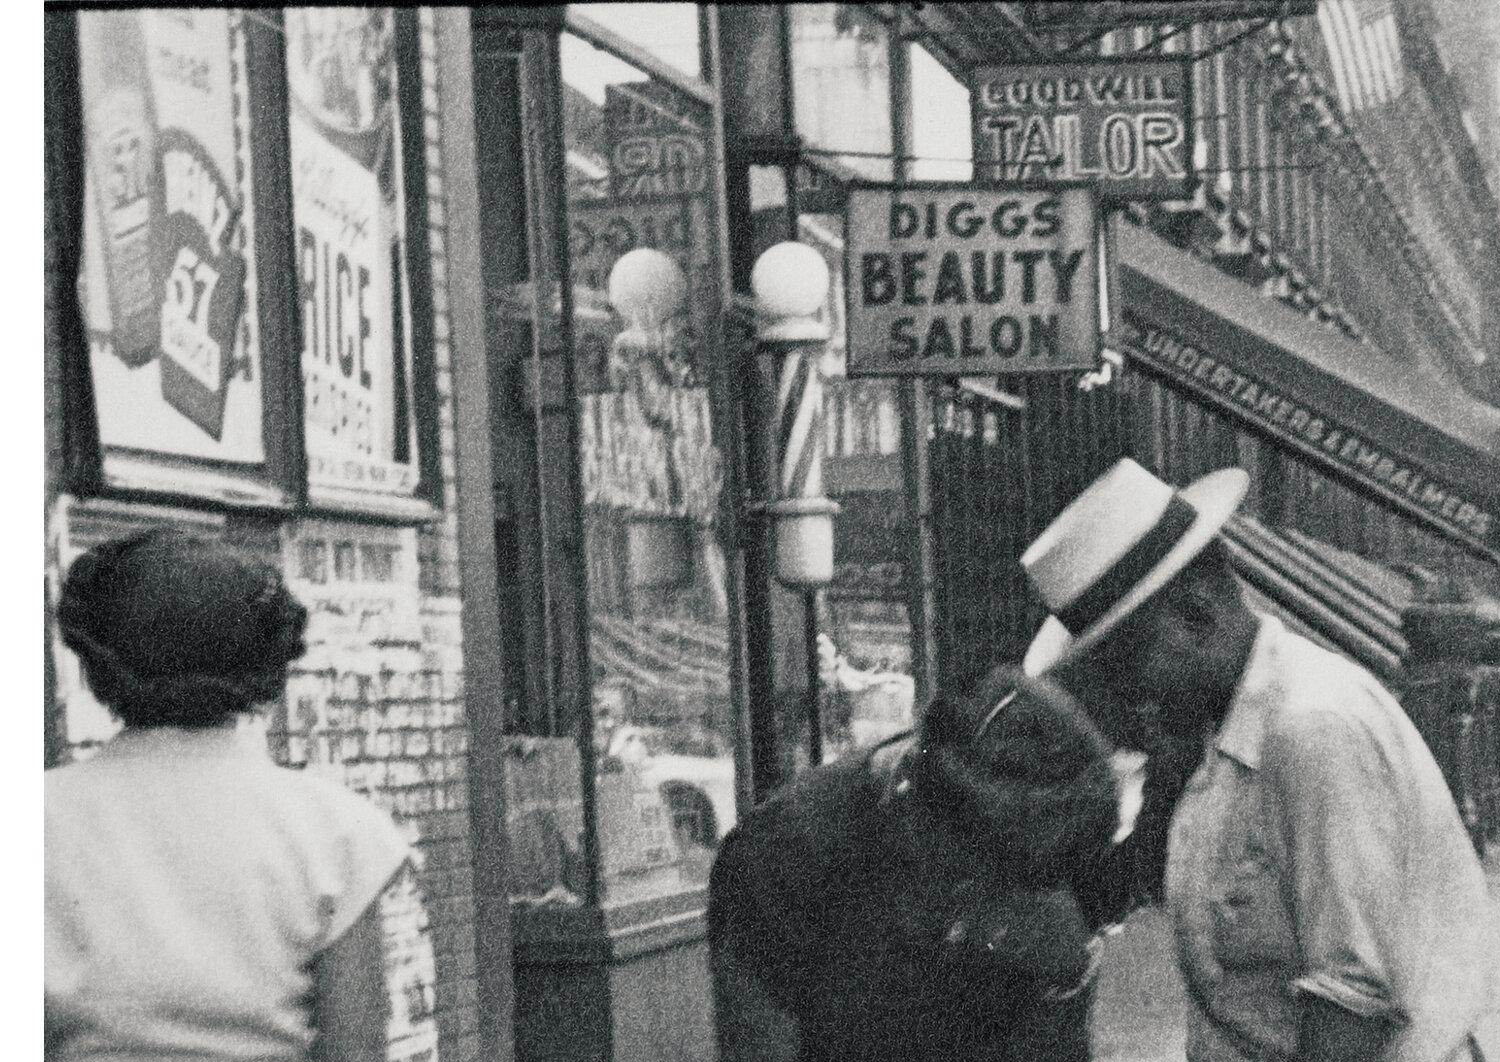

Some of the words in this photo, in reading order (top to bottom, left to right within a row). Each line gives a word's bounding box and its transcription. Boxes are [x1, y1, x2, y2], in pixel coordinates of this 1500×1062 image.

[980, 75, 1177, 109] GOODWILL
[980, 112, 1187, 181] TAILOR
[890, 199, 1064, 239] DIGGS
[861, 249, 1086, 306] BEAUTY
[300, 225, 372, 391] RICE
[890, 314, 1060, 361] SALON
[1144, 330, 1323, 441] UNDERTAKERS
[1339, 437, 1493, 535] EMBALMERS
